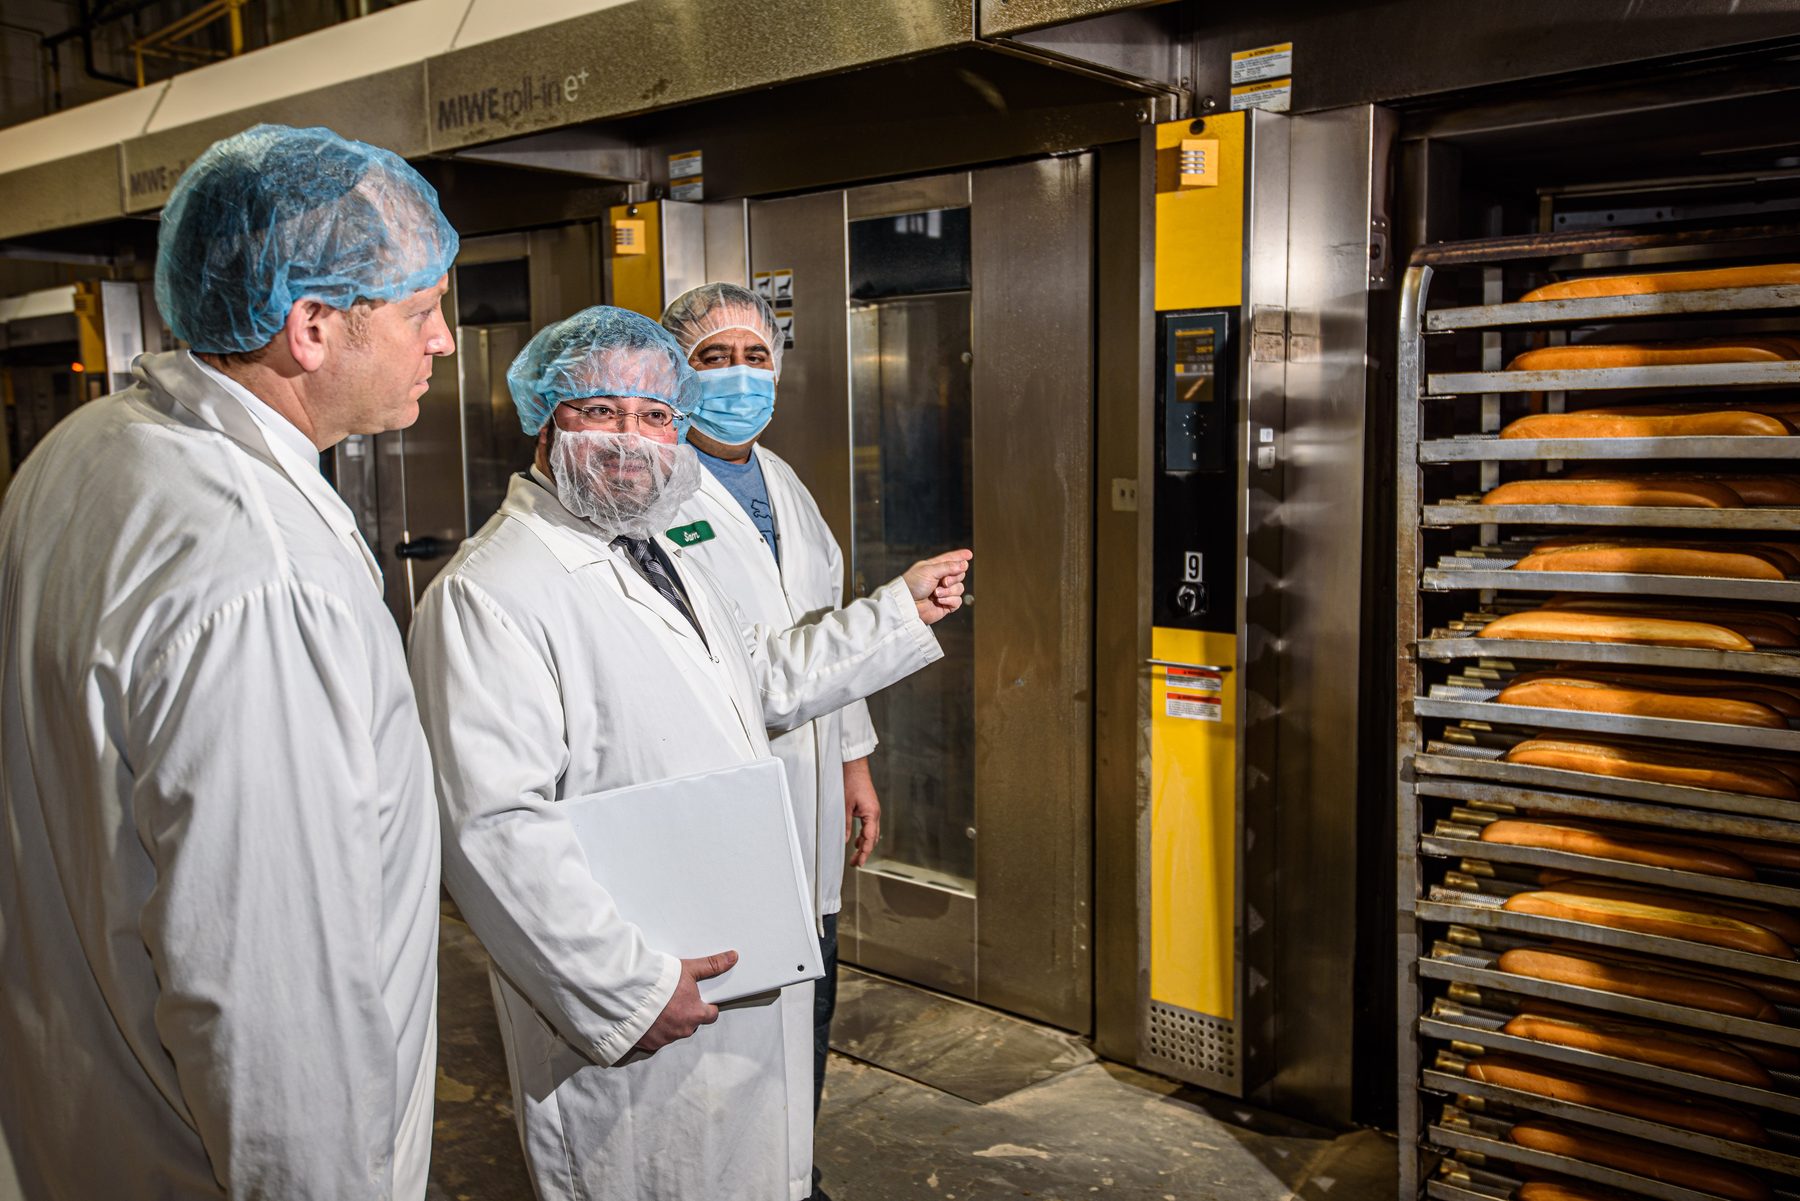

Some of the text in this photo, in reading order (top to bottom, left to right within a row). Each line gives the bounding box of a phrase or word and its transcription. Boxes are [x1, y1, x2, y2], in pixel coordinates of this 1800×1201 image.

[438, 88, 498, 132] MIWE
[503, 75, 561, 115] roll-in
[130, 166, 167, 197] MIWE
[1188, 554, 1199, 580] 9
